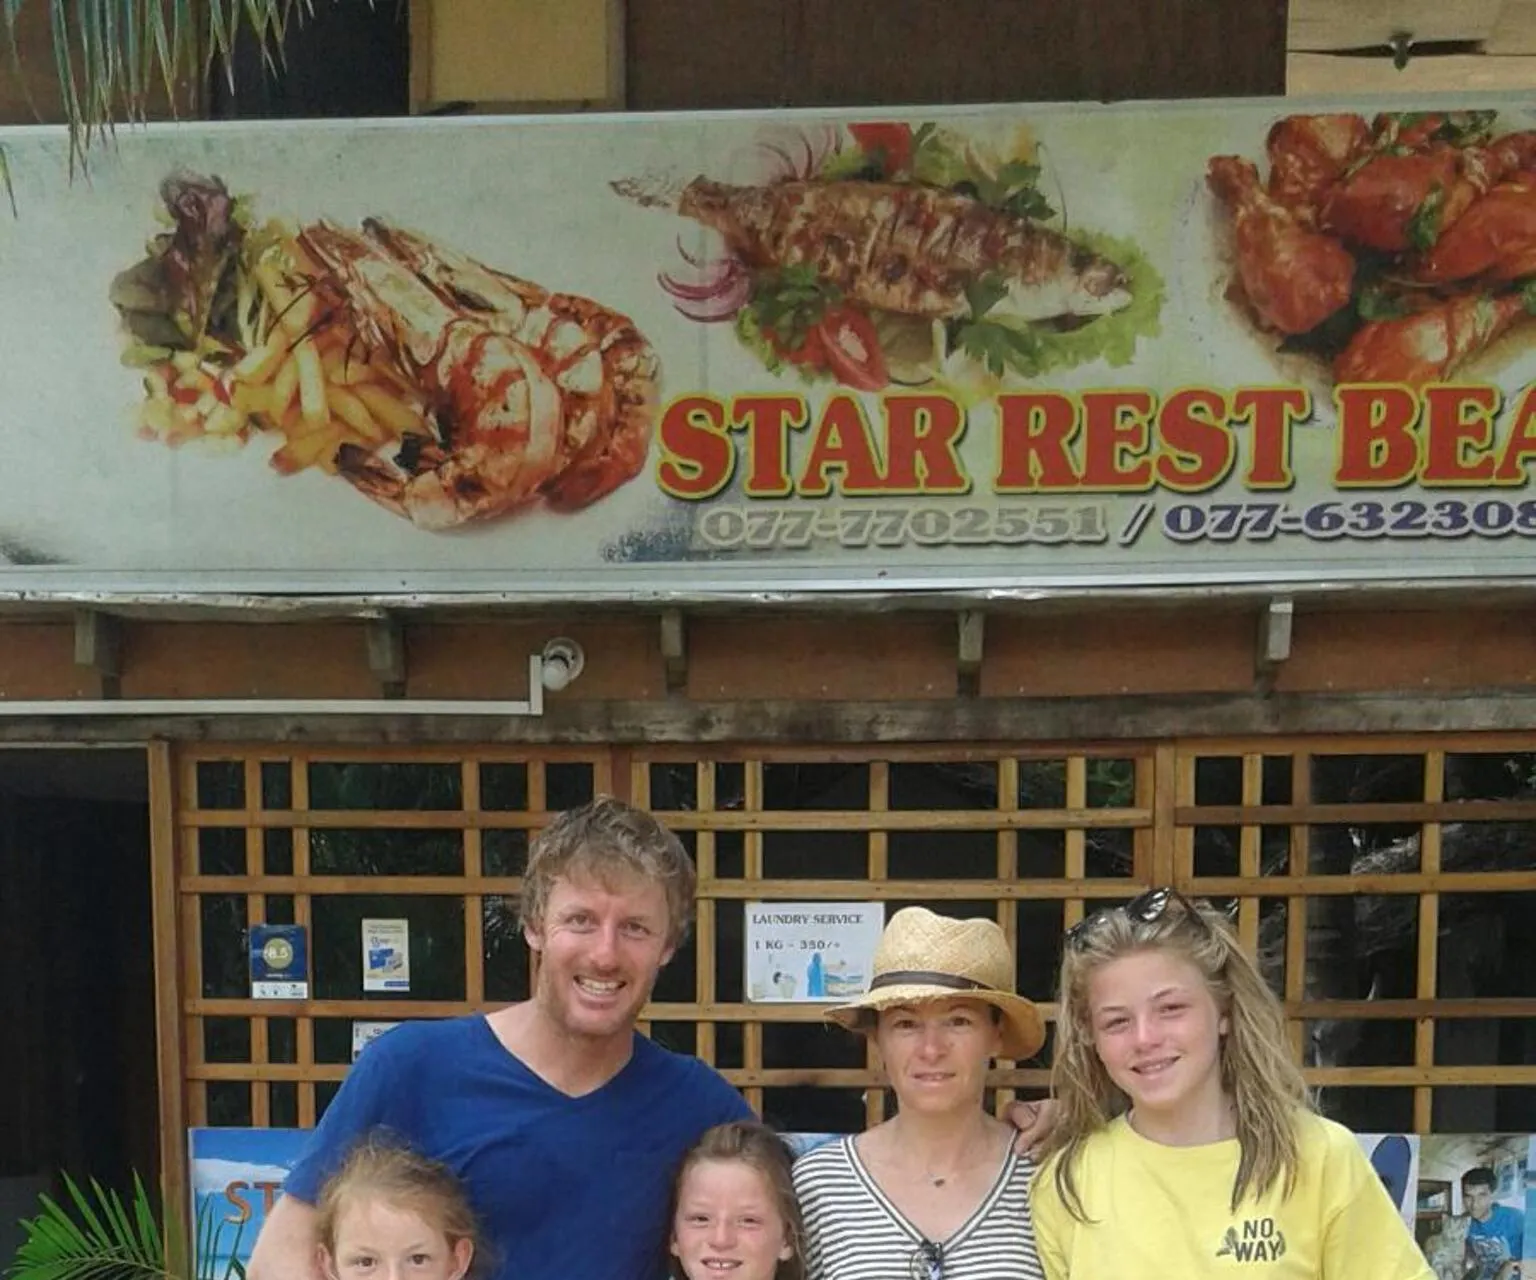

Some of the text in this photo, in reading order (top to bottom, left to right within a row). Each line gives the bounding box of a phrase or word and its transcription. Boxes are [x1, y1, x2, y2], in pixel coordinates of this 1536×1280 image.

[656, 391, 972, 499] STAR
[993, 386, 1312, 495] REST
[701, 502, 1108, 549] 077-7702551
[752, 914, 862, 925] LAUNDRY SERVICE
[766, 940, 784, 950] KG
[1243, 1218, 1274, 1239] NO
[1234, 1240, 1281, 1262] WAY
